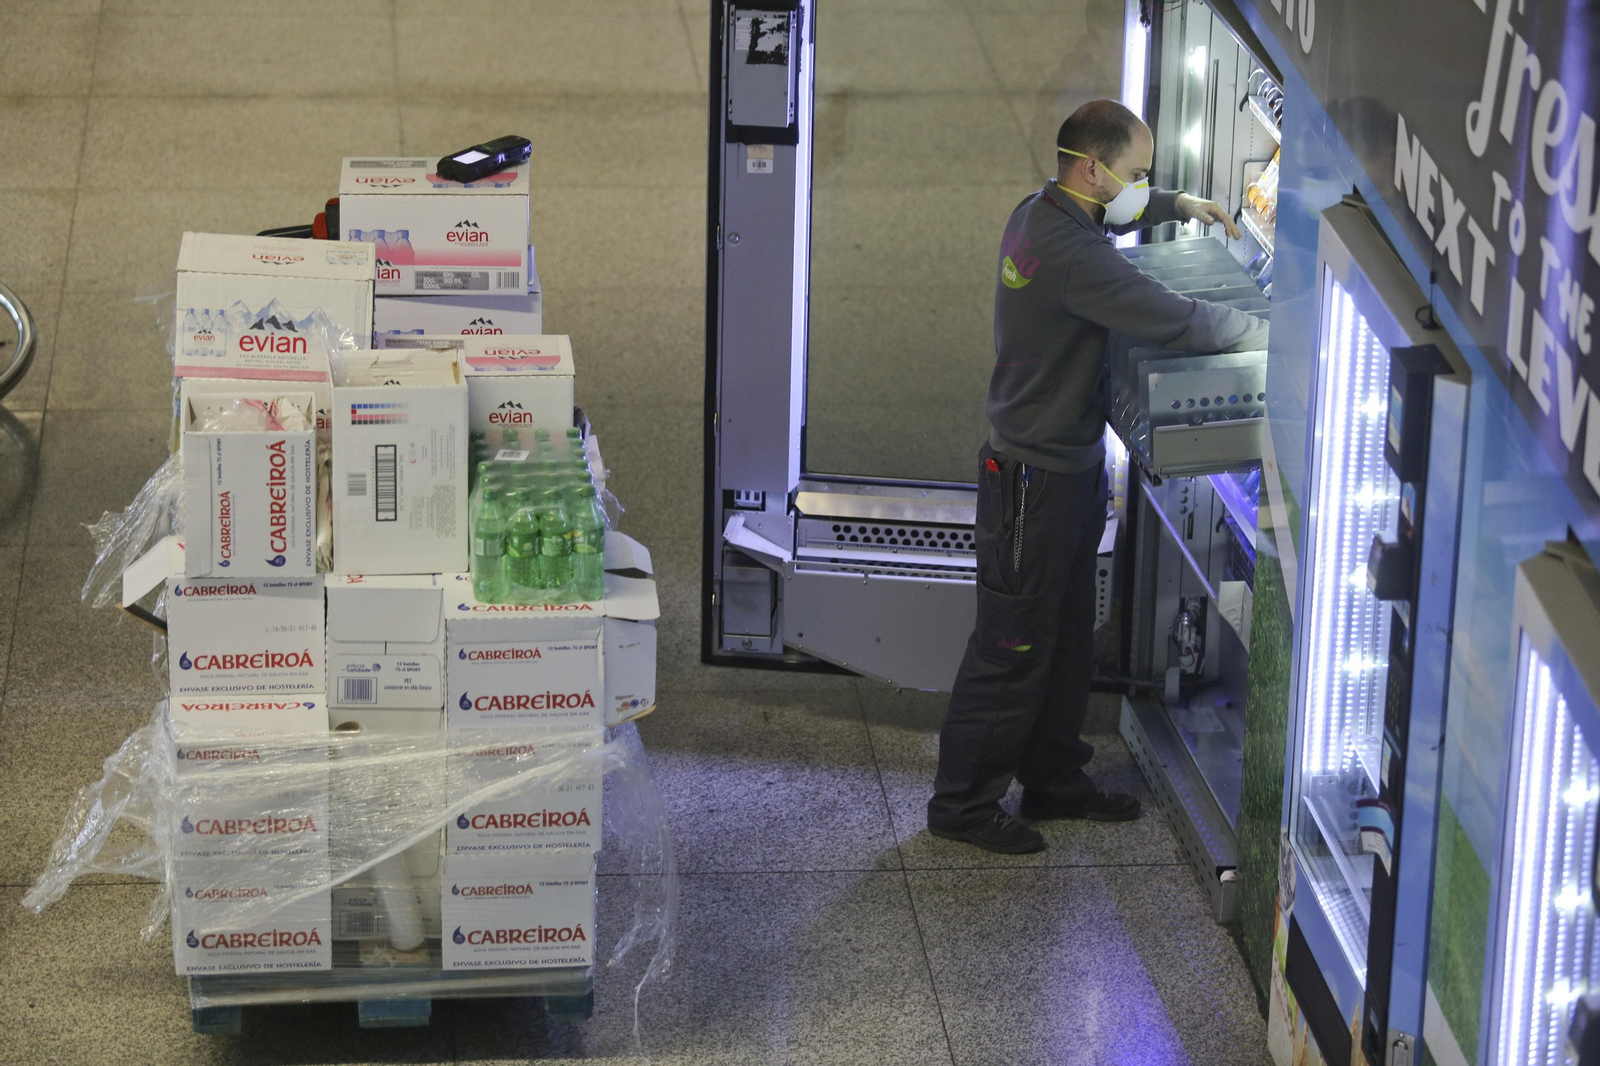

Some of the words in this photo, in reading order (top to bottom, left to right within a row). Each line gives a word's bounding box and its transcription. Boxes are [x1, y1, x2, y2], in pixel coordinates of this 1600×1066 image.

[355, 176, 416, 184] evian
[1394, 113, 1495, 317] NEXT
[1492, 170, 1526, 257] TO
[446, 228, 489, 243] evian
[252, 253, 305, 262] evian
[377, 266, 400, 280] ian
[1540, 236, 1595, 355] THE
[193, 333, 215, 342] evian
[238, 332, 307, 354] evian
[484, 347, 541, 356] evian
[488, 409, 533, 424] evian
[266, 439, 286, 554] CABREIROÁ
[305, 485, 311, 495] DE
[217, 491, 231, 559] CABREIROÁ
[183, 582, 257, 597] CABREIROÁ
[193, 648, 314, 671] CABREIROÁ
[468, 647, 542, 660] CABREIROÁ
[474, 689, 595, 711] CABREIROÁ
[195, 813, 318, 835] CABREIROÁ
[471, 808, 591, 830] CABREIROÁ
[460, 882, 534, 897] CABREIROÁ
[201, 927, 322, 949] CABREIROÁ
[467, 923, 587, 945] CABREIROÁ
[276, 961, 322, 969] HOSTELERÍA
